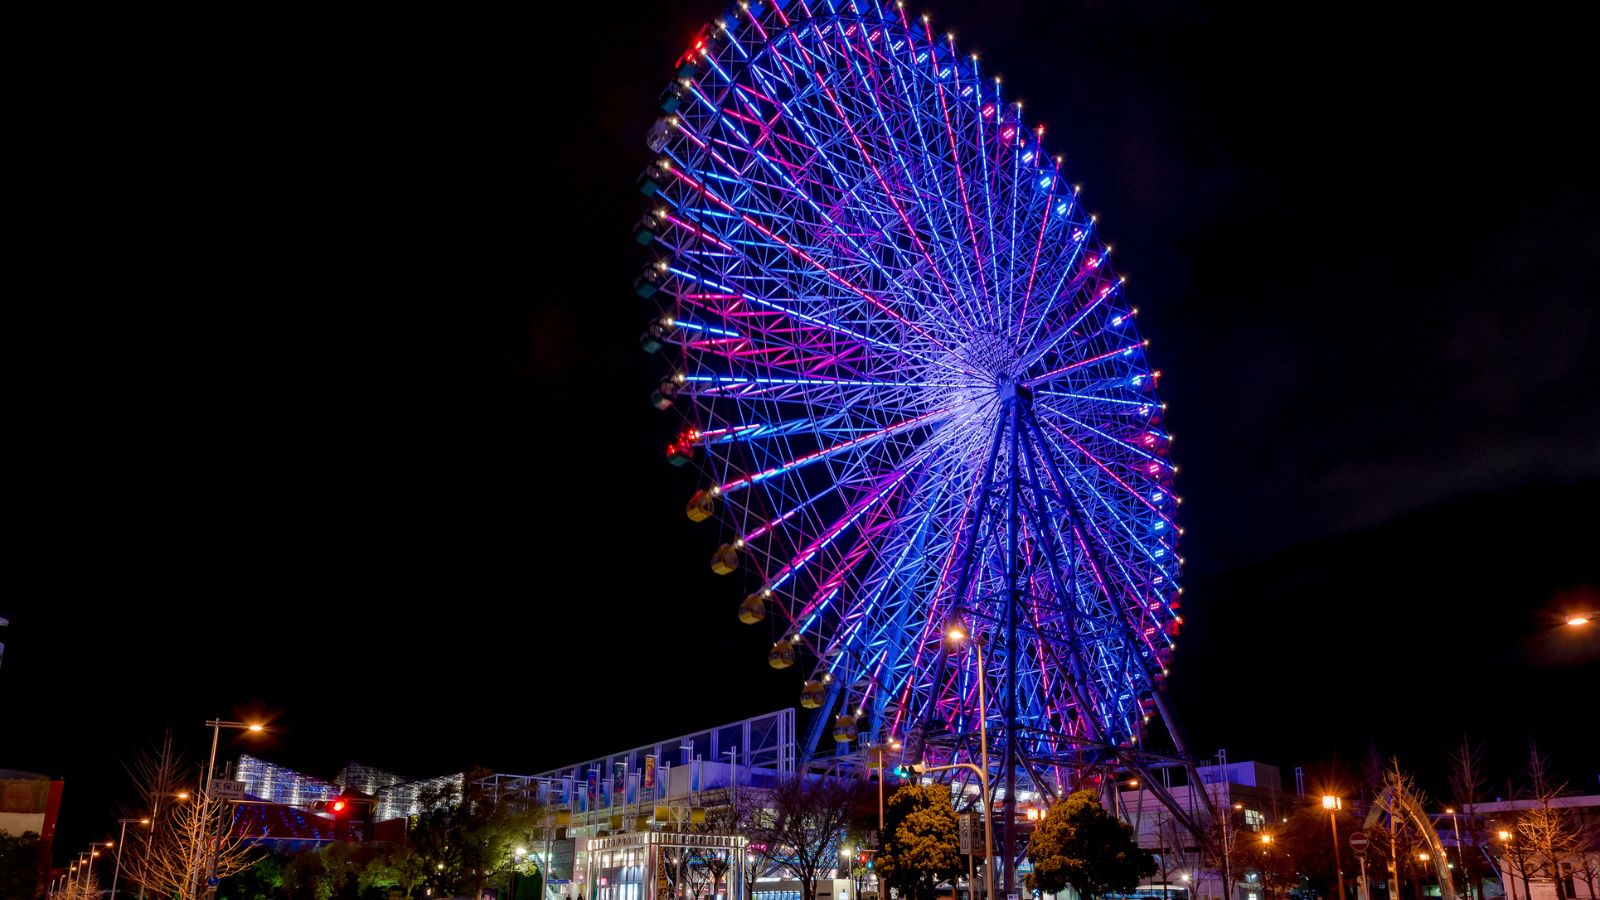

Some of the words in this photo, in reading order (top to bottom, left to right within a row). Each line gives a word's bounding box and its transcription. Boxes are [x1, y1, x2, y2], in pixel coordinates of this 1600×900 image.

[212, 781, 242, 792] 天保山
[961, 818, 969, 849] 天保山
[971, 818, 980, 849] 天保山
